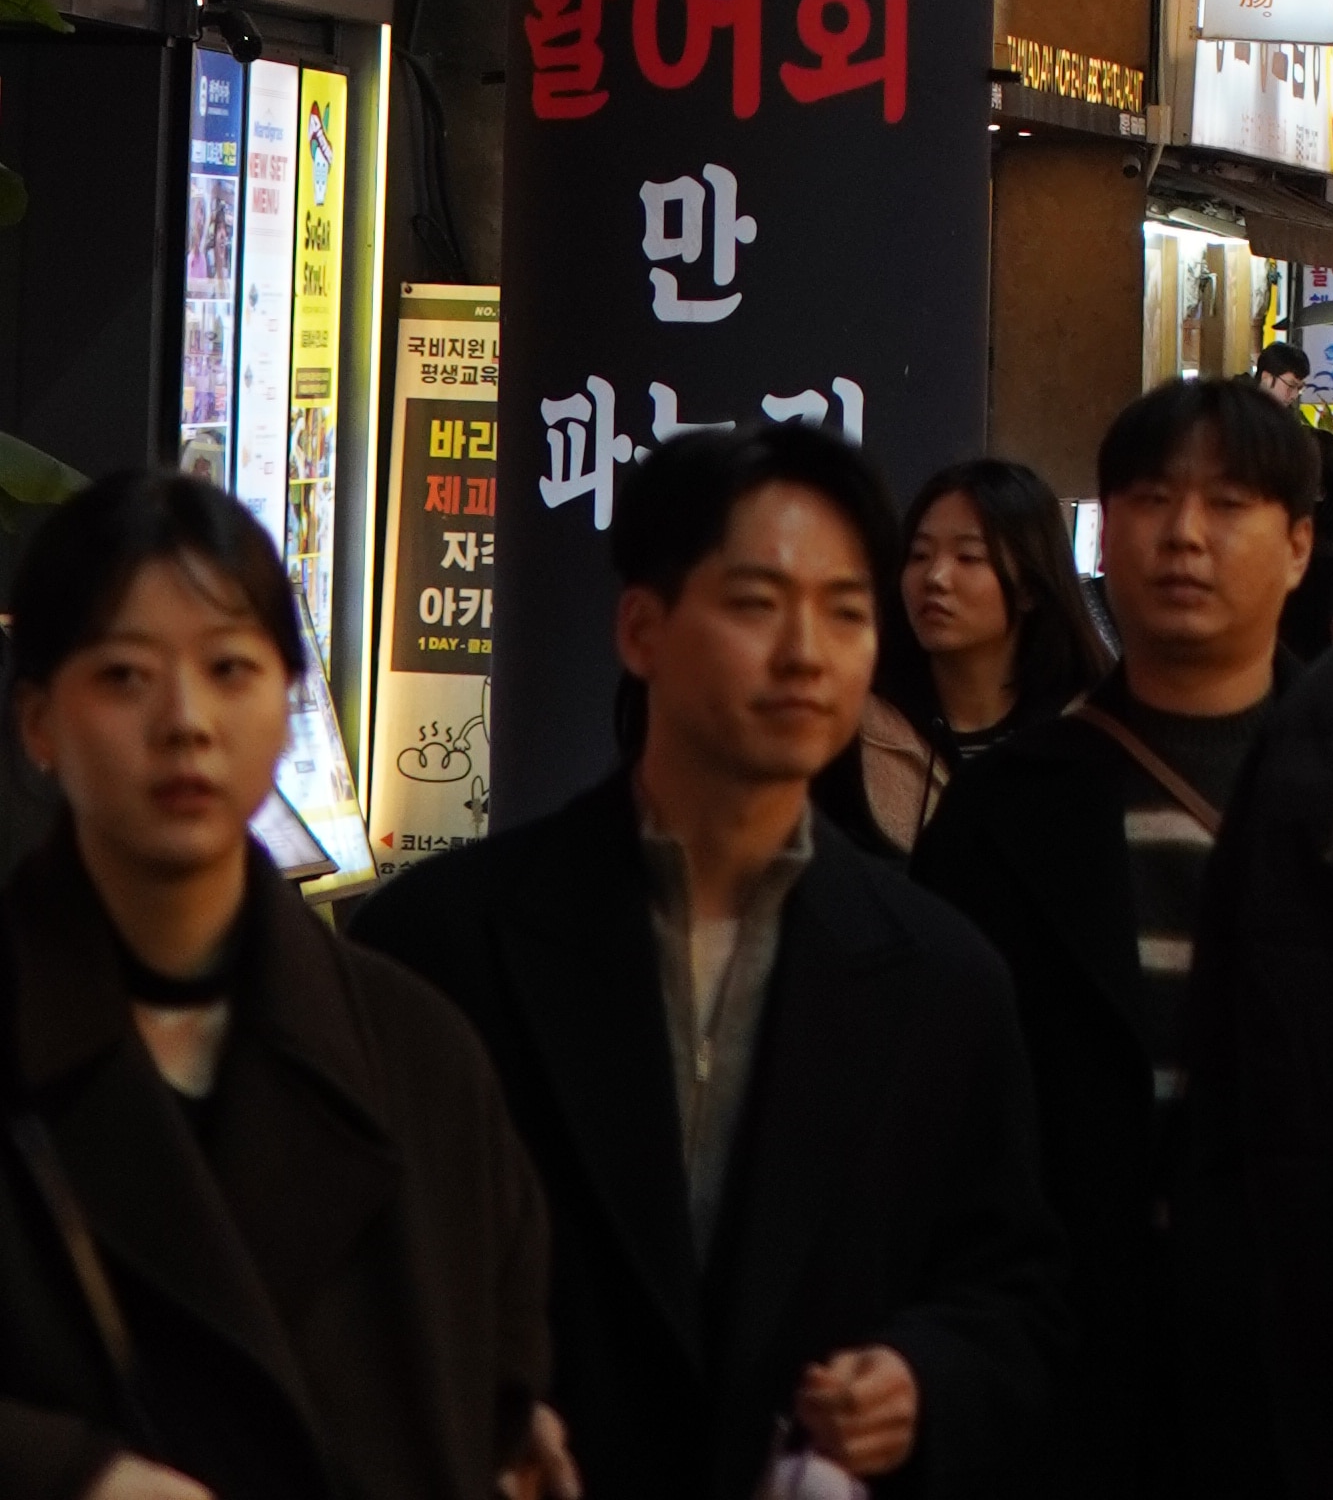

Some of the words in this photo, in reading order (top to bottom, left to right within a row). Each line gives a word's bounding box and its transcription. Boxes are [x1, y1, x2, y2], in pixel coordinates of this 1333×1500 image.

[251, 187, 280, 217] MENU
[637, 162, 758, 325] 만
[407, 336, 486, 360] 국비지원
[420, 363, 498, 387] 평생교육
[428, 637, 458, 652] DAY
